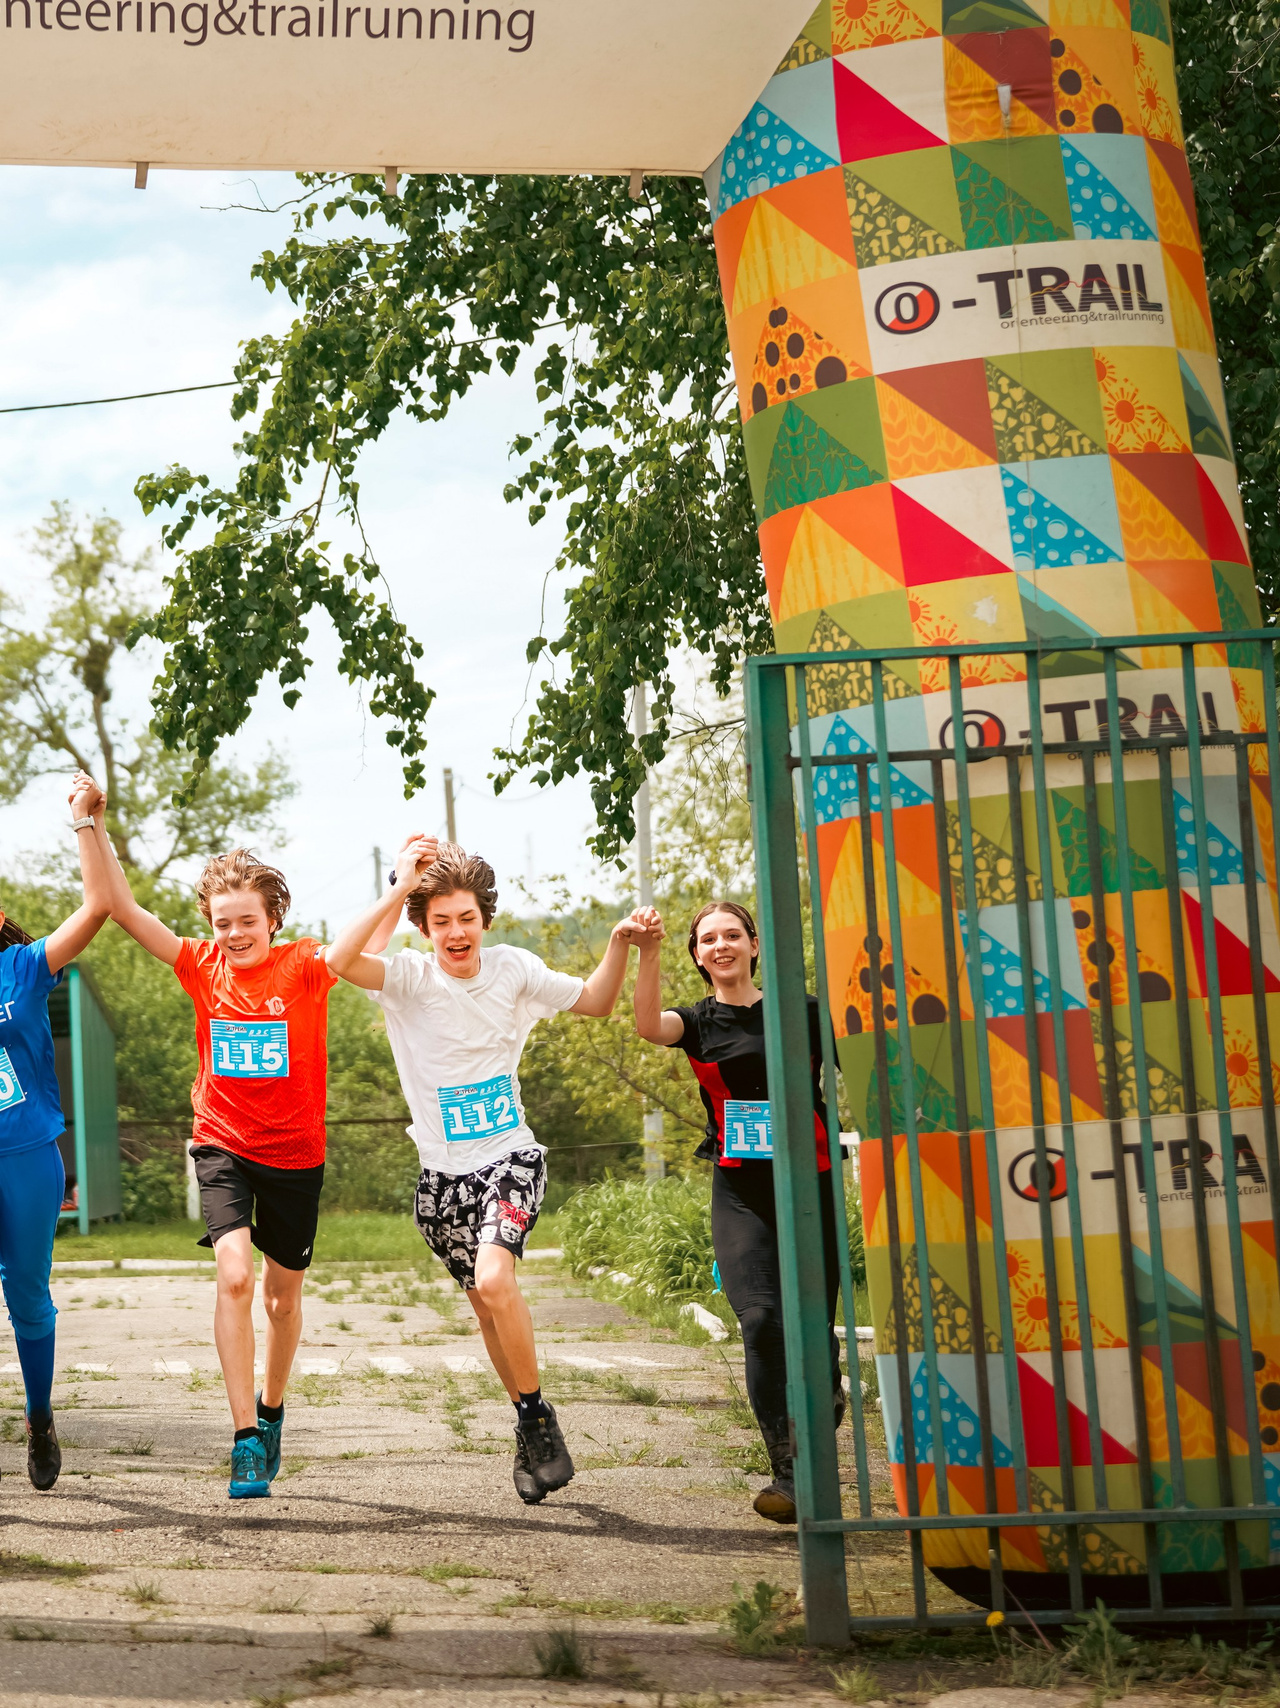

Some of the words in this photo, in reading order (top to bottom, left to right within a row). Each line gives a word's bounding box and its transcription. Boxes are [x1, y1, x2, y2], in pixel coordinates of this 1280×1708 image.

[218, 1040, 284, 1071] 115
[448, 1095, 513, 1134] 112
[731, 1122, 773, 1152] 11
